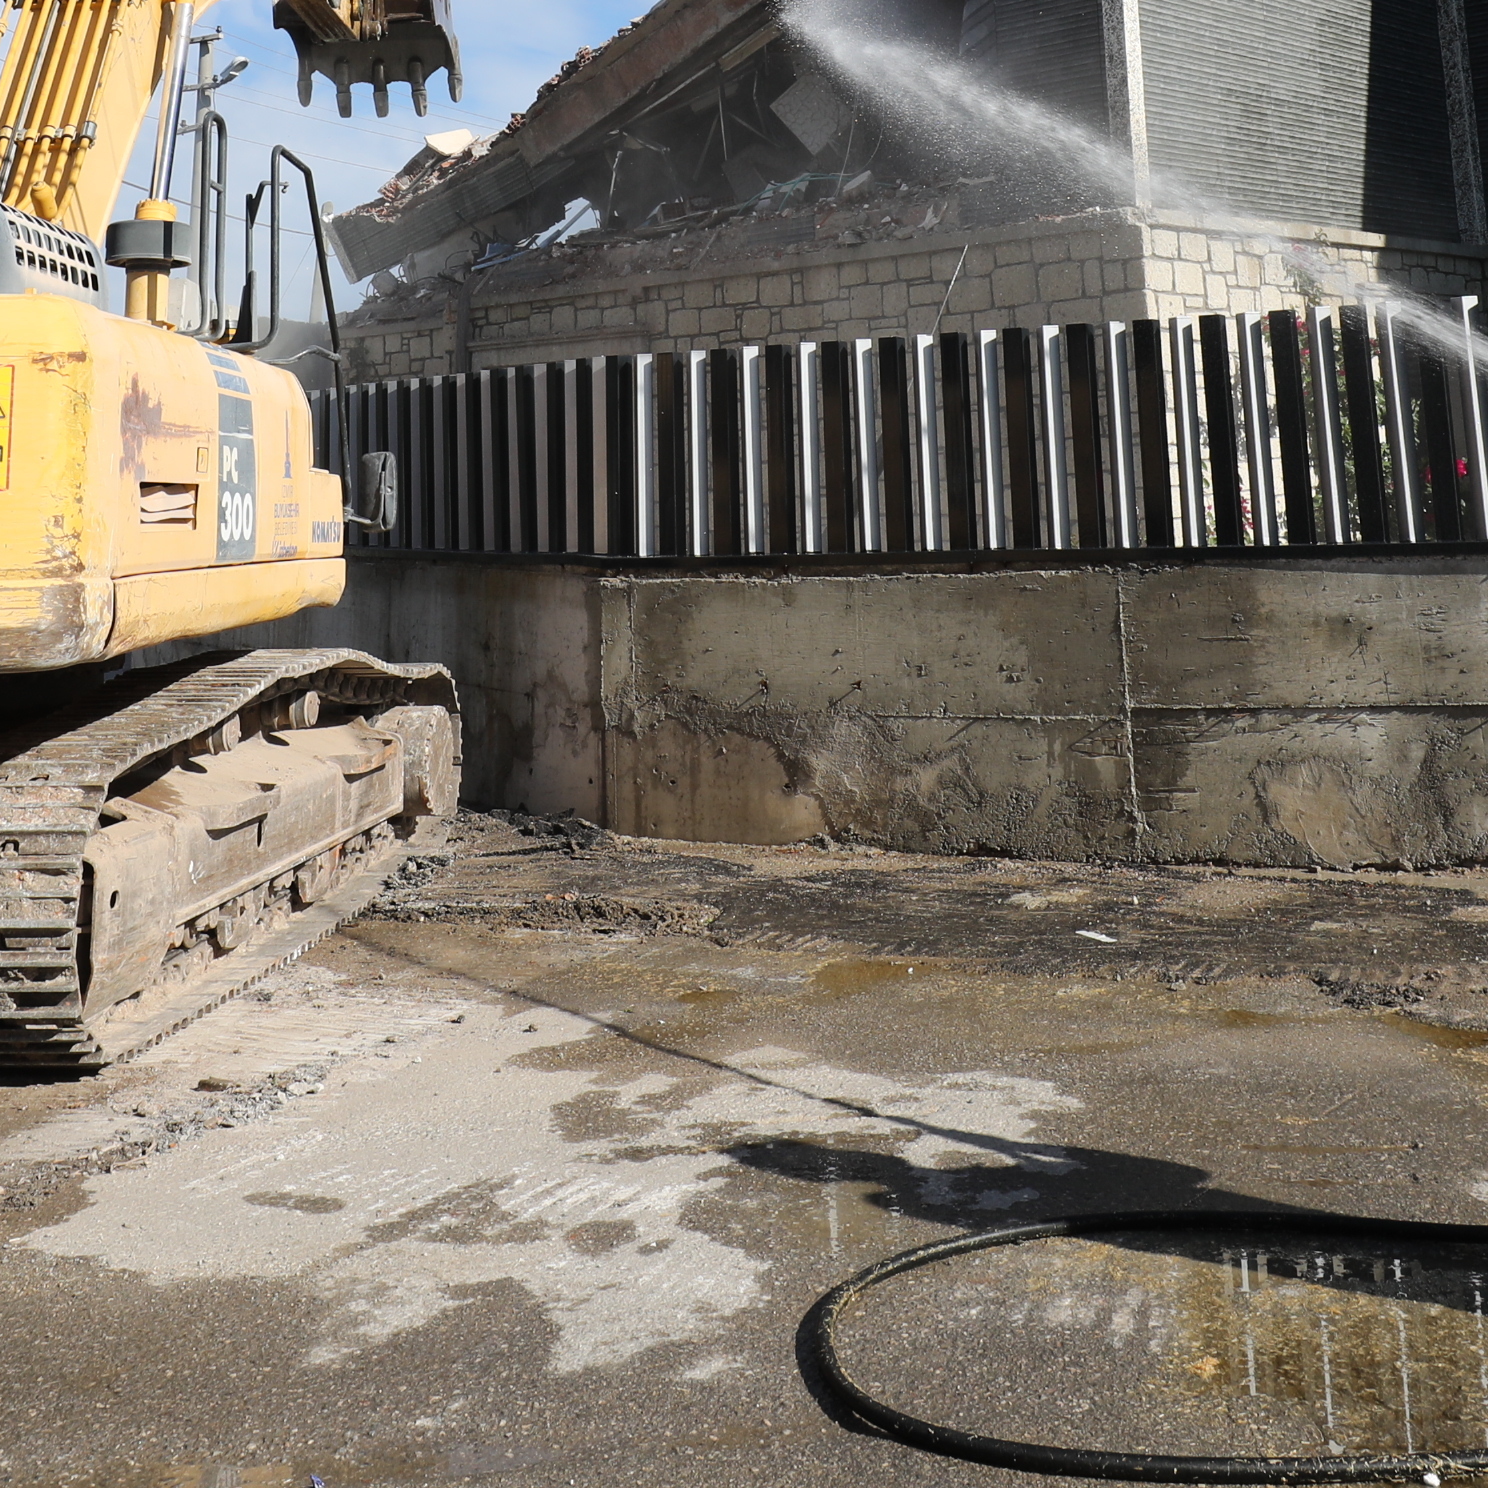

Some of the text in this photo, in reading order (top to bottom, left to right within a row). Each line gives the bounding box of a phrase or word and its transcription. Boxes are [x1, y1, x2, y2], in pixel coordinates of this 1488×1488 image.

[222, 444, 238, 484] PC
[220, 491, 253, 541] 300
[311, 515, 342, 543] KOMATSU
